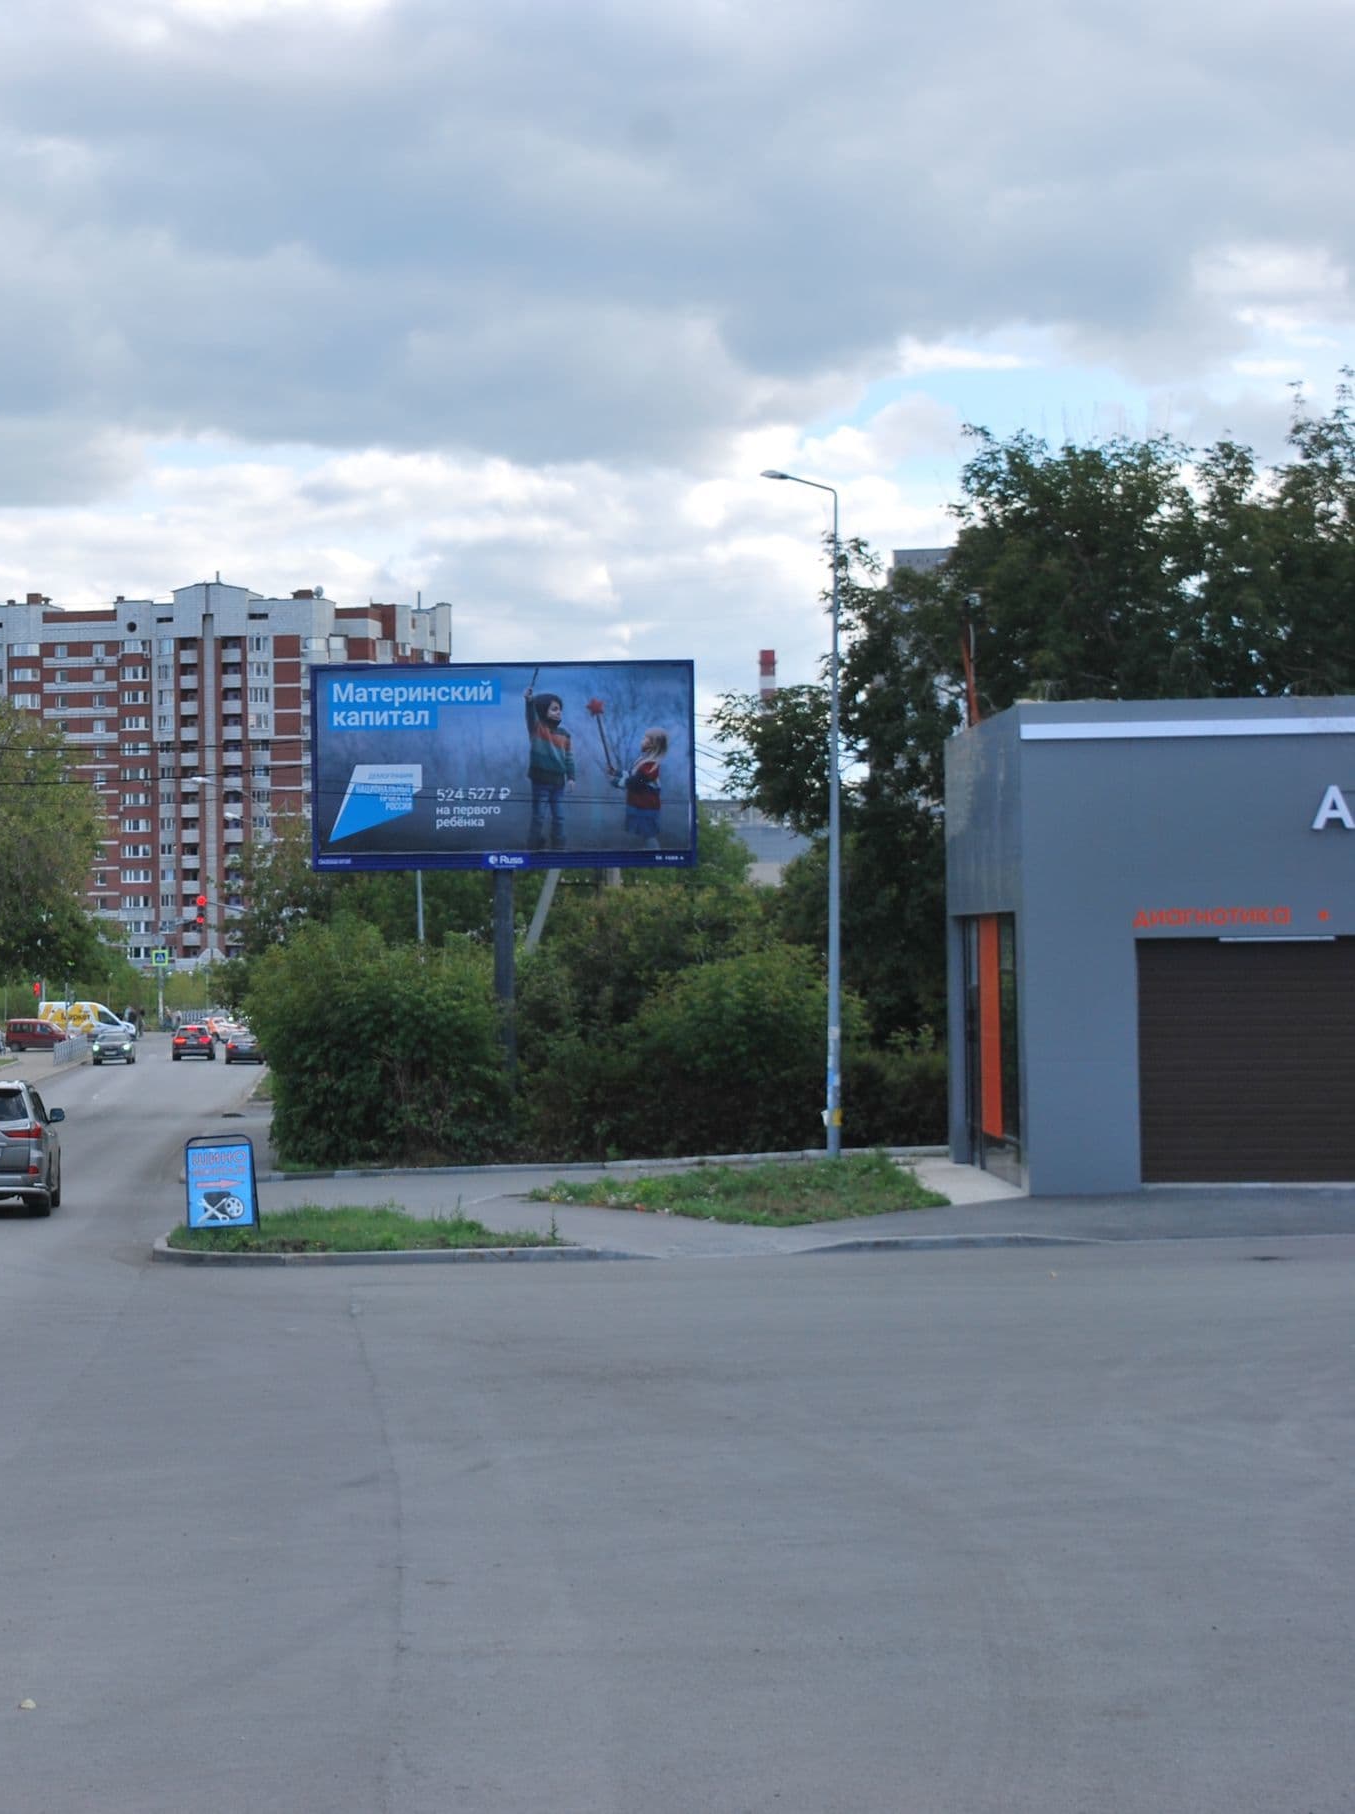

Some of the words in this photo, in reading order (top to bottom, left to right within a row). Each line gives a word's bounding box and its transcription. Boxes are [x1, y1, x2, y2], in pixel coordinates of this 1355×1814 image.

[332, 680, 493, 707] Материнский
[332, 709, 430, 727] капитал
[436, 788, 464, 801] 524
[468, 787, 495, 800] 527
[436, 806, 451, 815] на
[453, 806, 501, 817] первого
[436, 816, 485, 829] ребёнка
[499, 855, 524, 865] Russ
